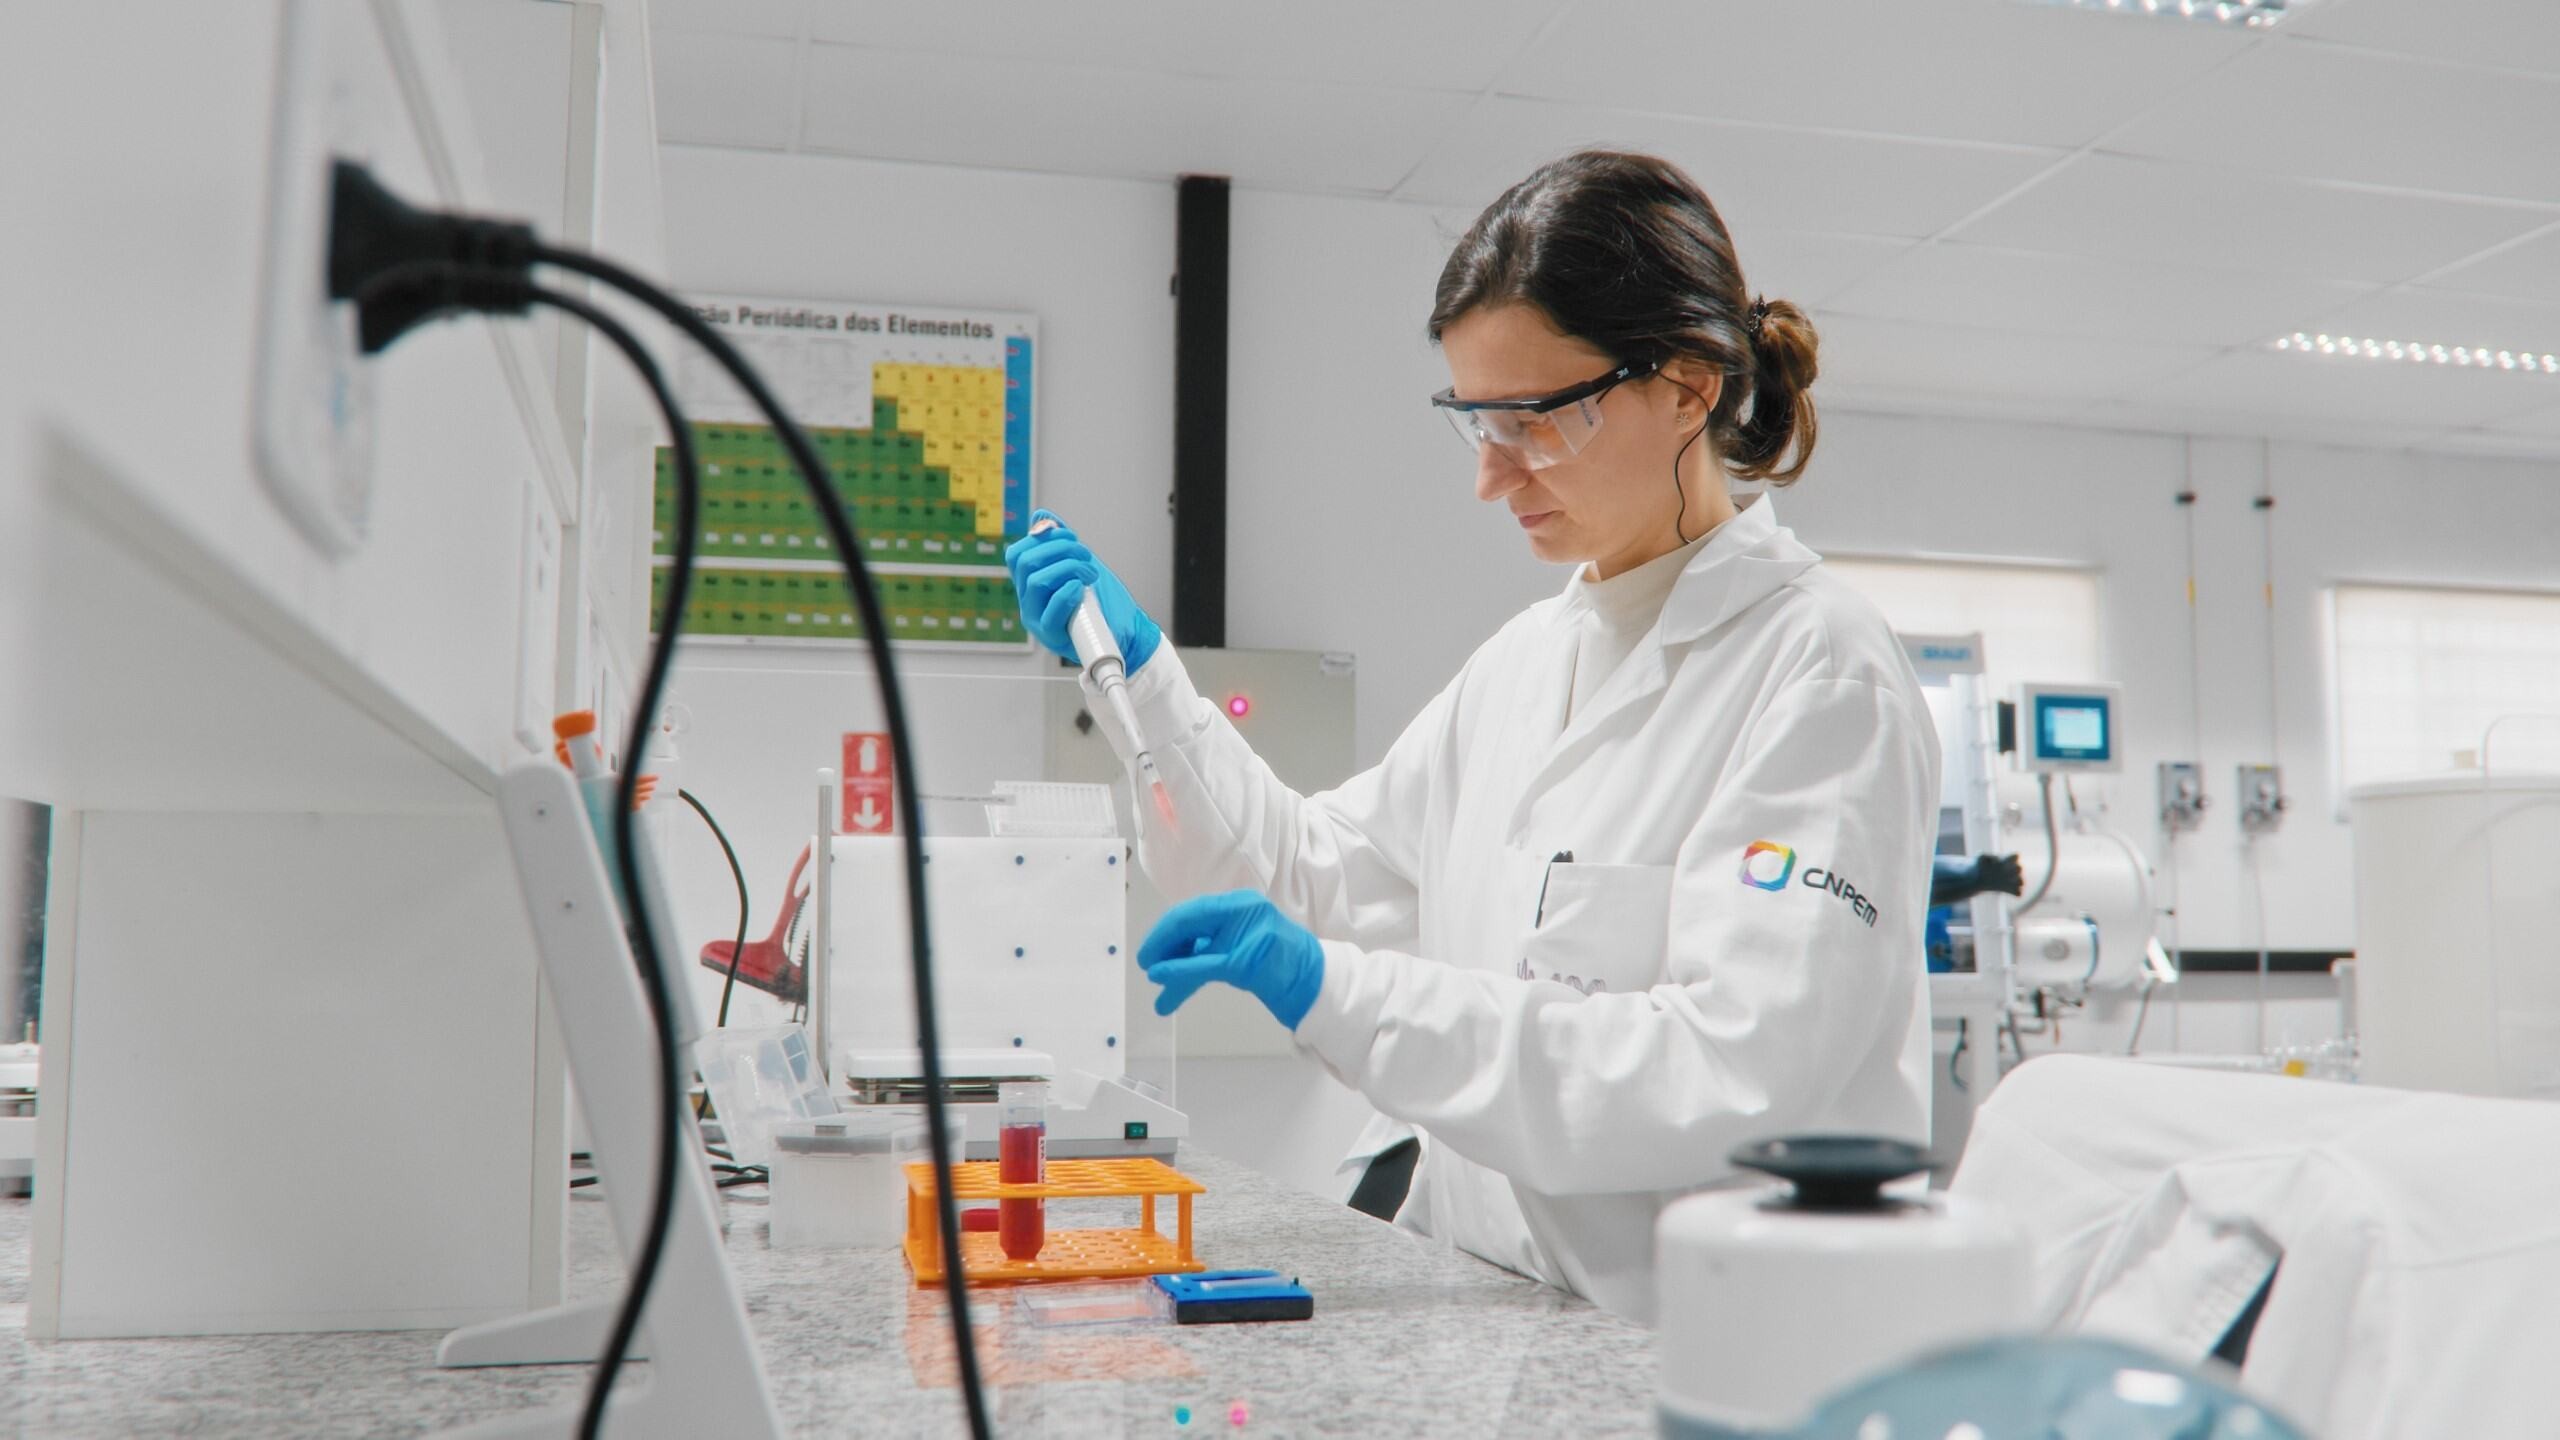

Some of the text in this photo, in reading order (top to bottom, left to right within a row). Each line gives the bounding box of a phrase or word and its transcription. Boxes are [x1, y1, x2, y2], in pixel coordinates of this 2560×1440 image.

[738, 306, 838, 330] Periódica
[844, 312, 881, 332] dos
[888, 314, 993, 338] Elementos
[1802, 867, 1878, 927] CNPEM
